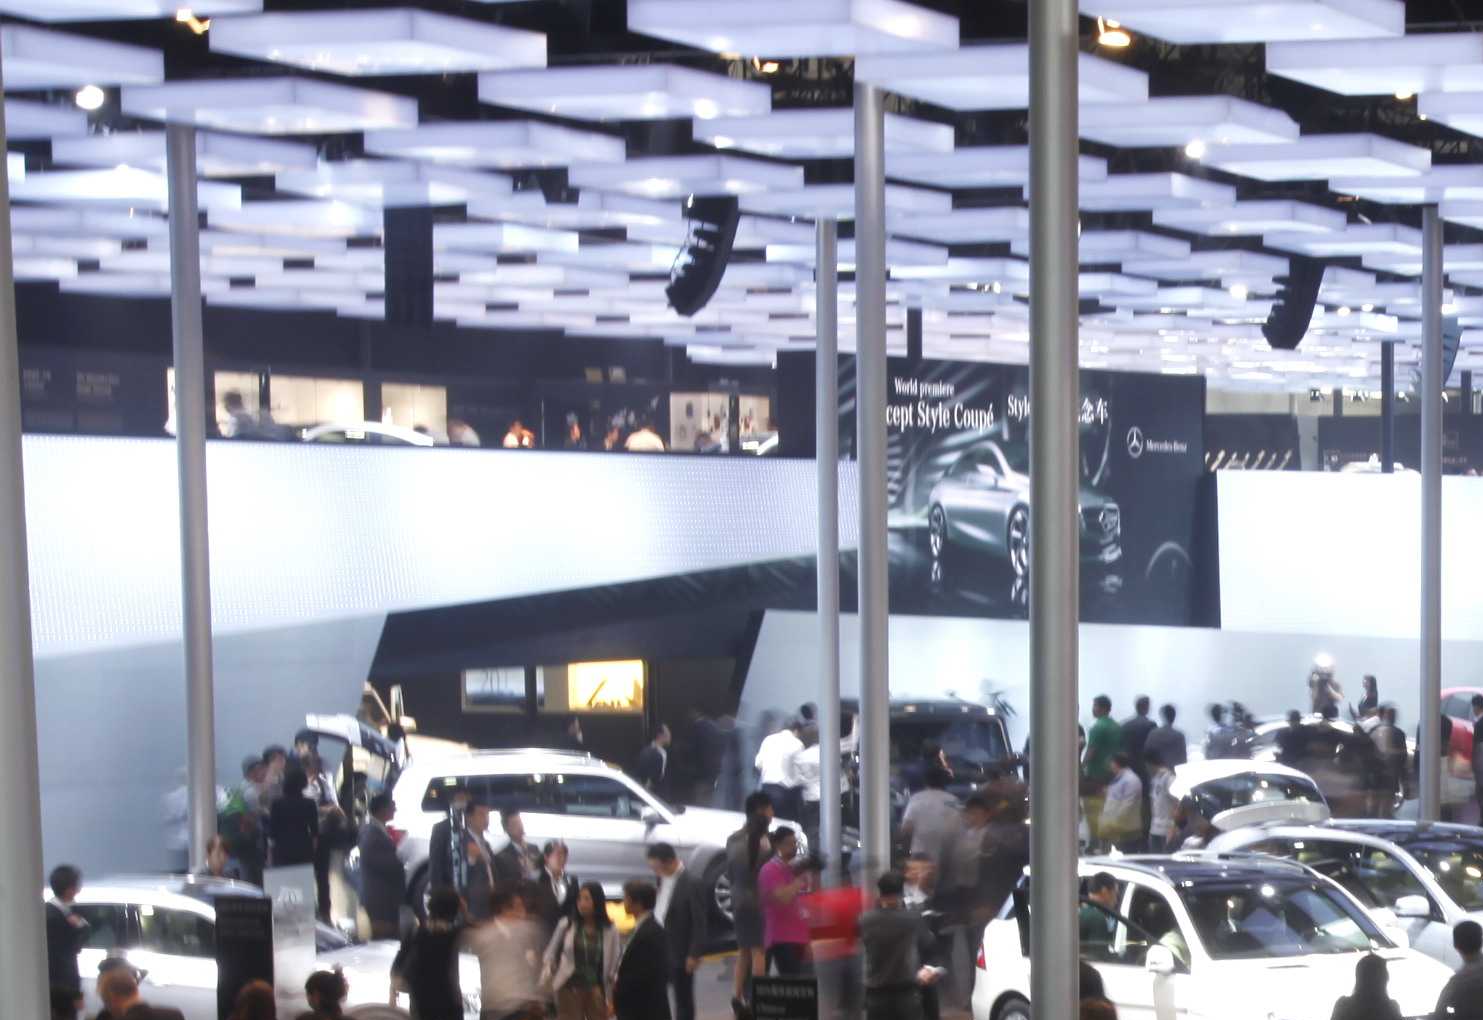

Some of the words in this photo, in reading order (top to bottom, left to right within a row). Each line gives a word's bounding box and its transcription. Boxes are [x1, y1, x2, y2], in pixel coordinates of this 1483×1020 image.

[894, 377, 918, 396] World
[919, 380, 955, 399] premiere
[886, 402, 914, 433] cept
[917, 400, 951, 434] Style
[953, 402, 994, 436] Coupé
[1078, 397, 1109, 425] 念车
